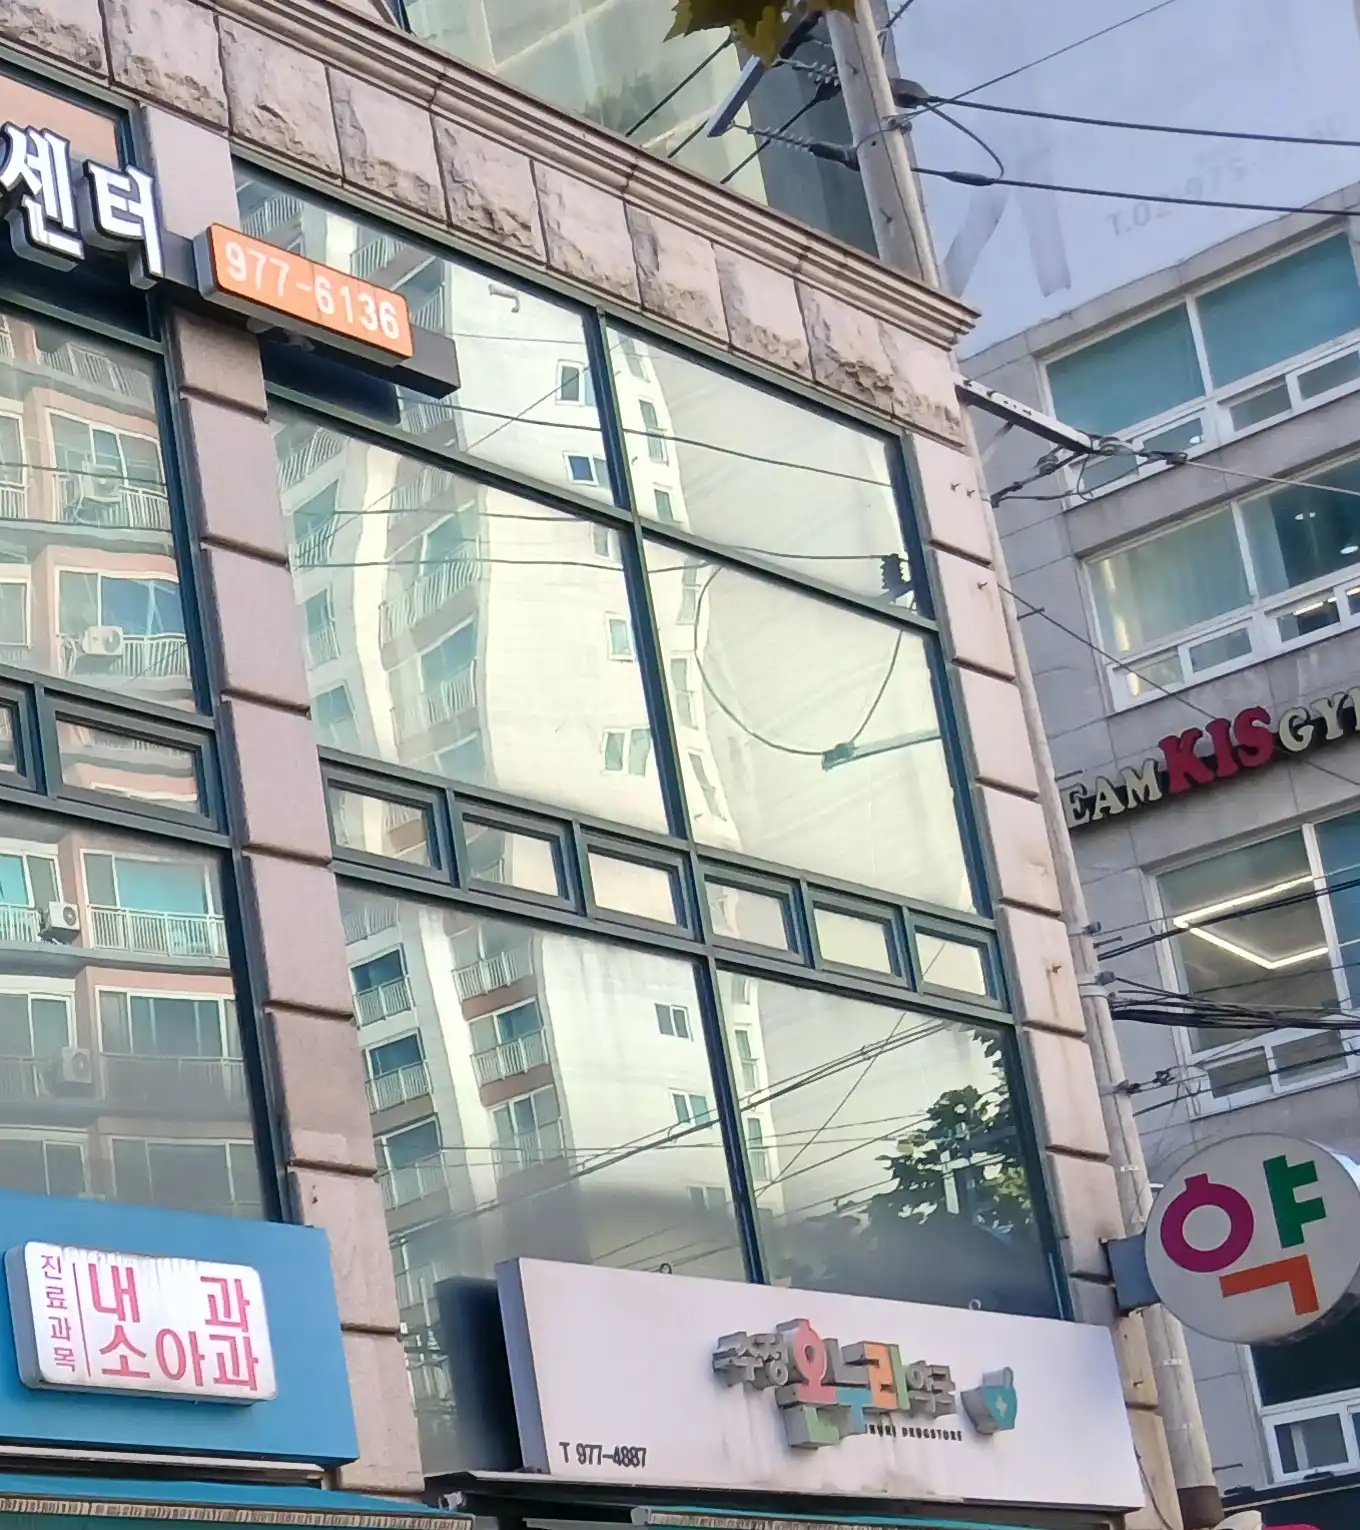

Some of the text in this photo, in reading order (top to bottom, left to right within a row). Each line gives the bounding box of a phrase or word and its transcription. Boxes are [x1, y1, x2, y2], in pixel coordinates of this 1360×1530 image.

[221, 241, 403, 340] 977-6136
[1159, 1154, 1327, 1316] 약
[40, 1254, 76, 1372] 진료과목
[99, 1325, 259, 1392] 소아과
[575, 1442, 647, 1469] 977-4887
